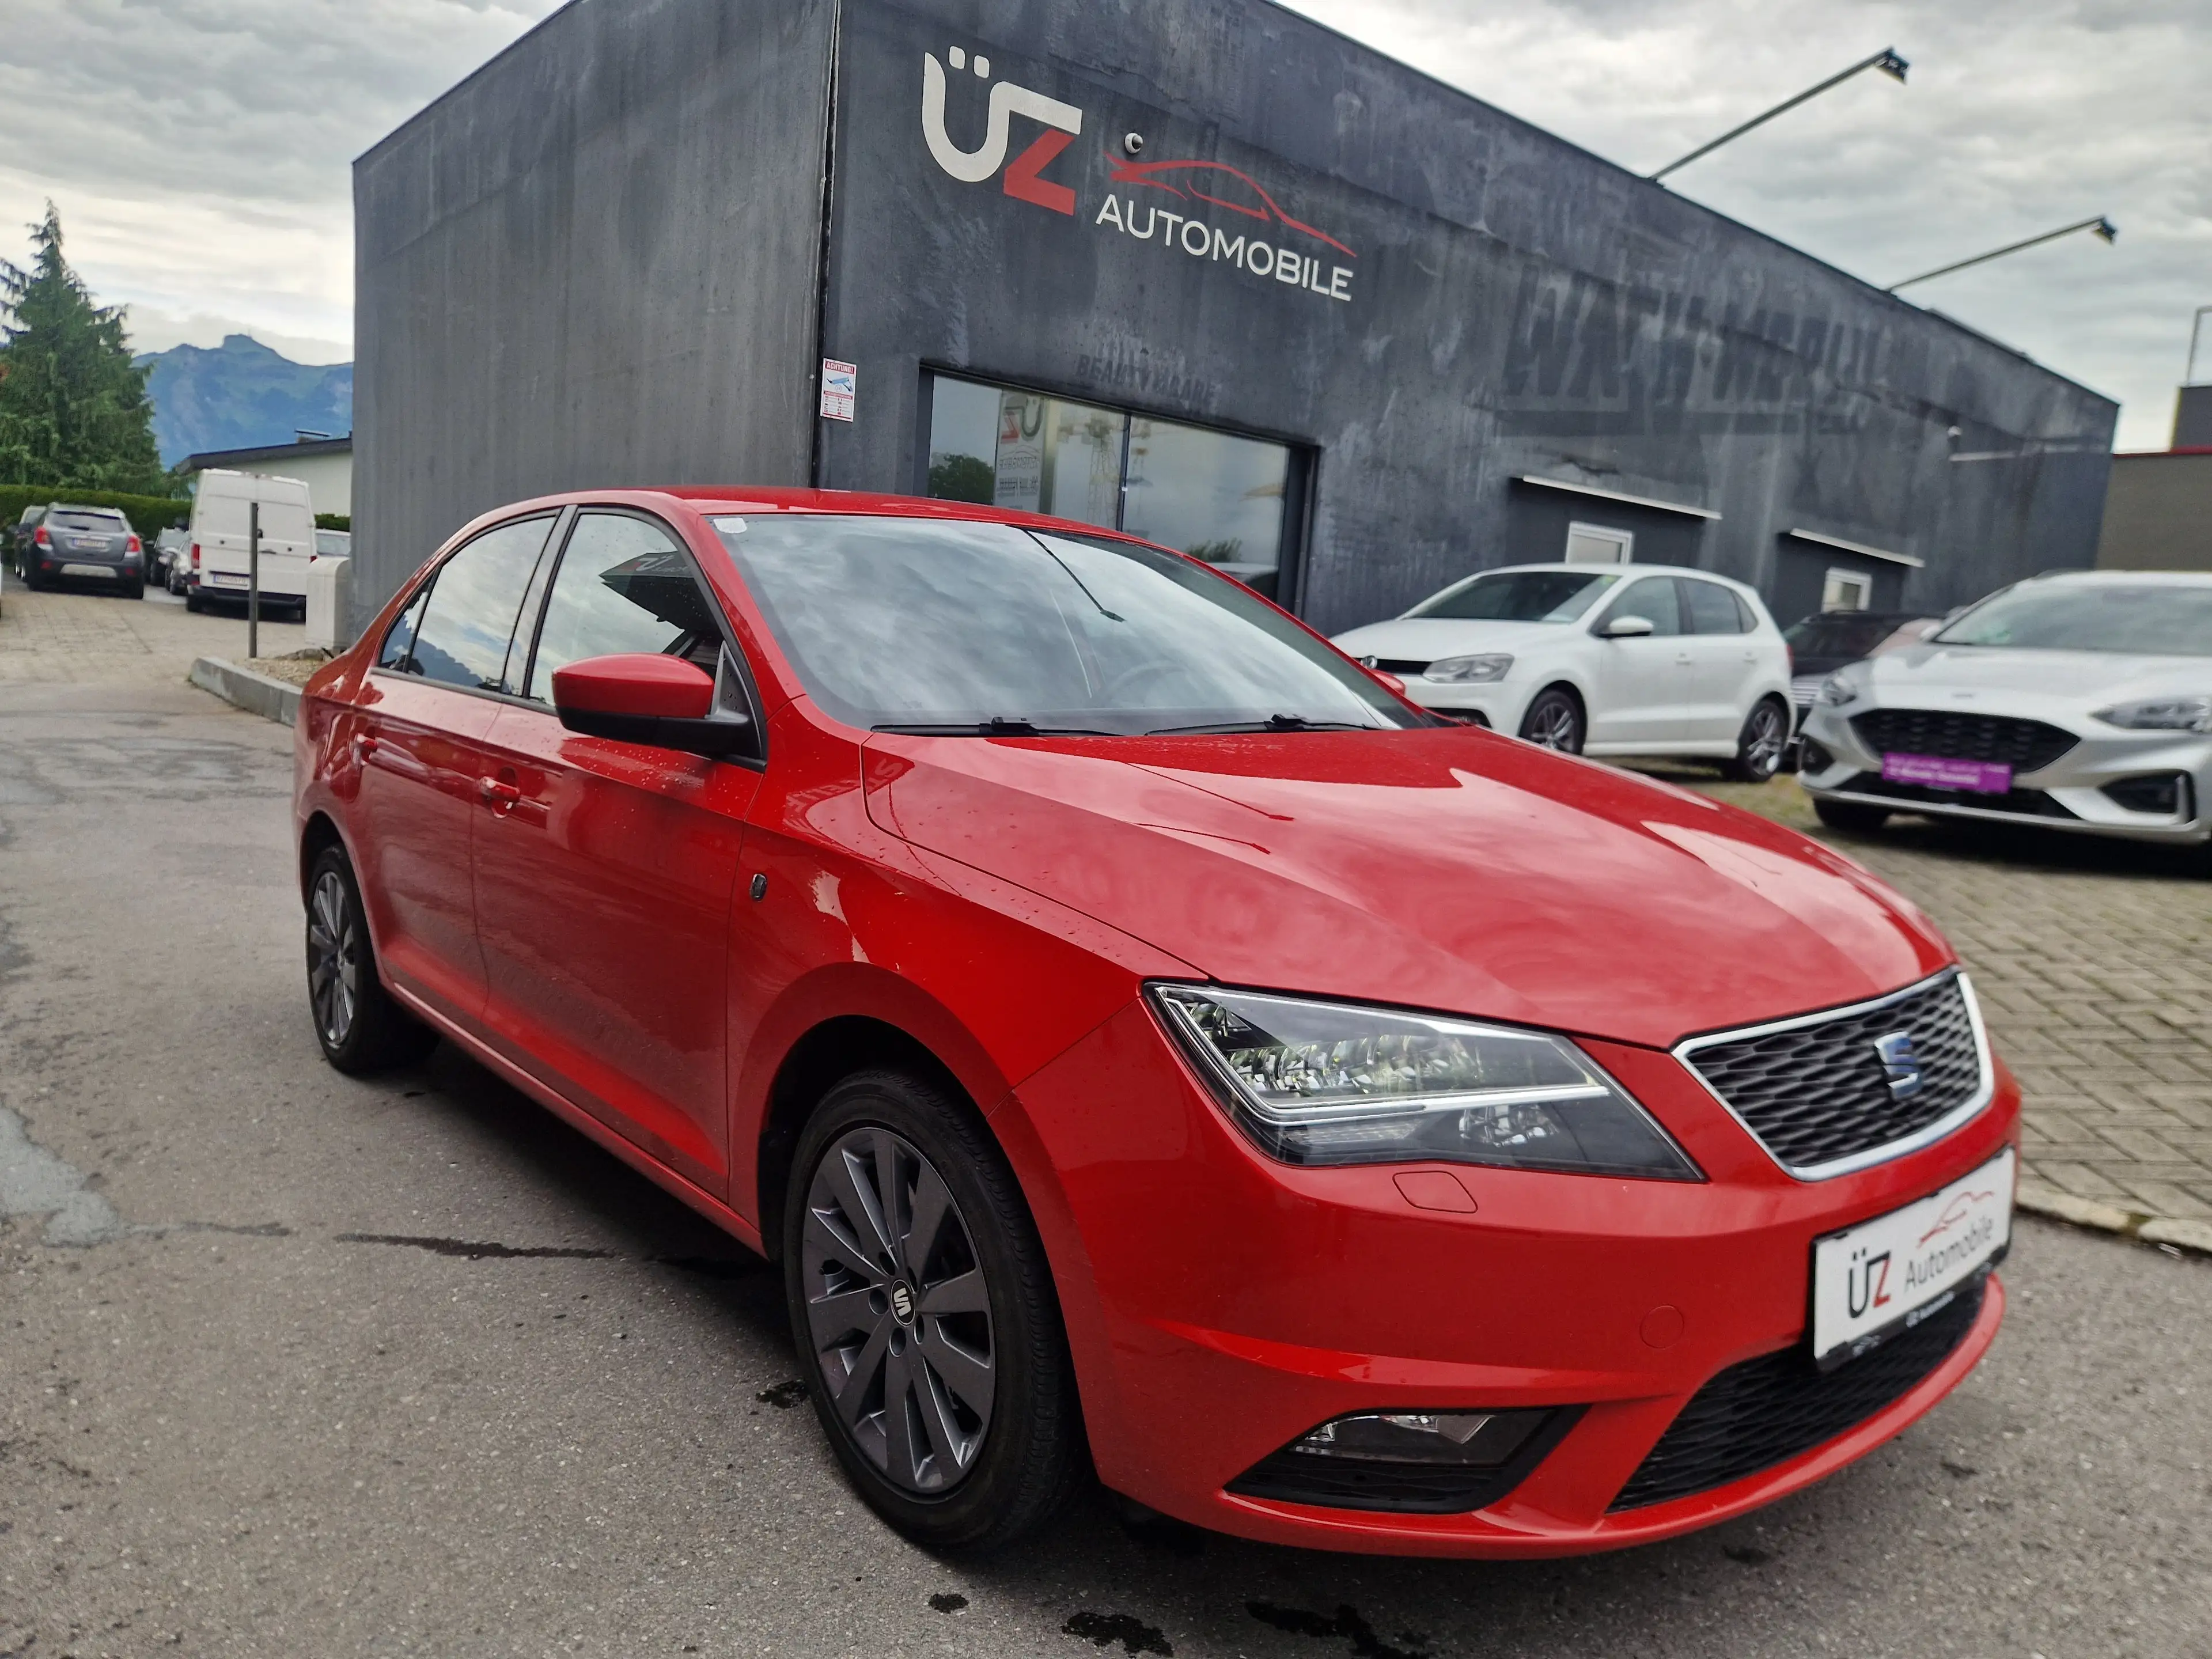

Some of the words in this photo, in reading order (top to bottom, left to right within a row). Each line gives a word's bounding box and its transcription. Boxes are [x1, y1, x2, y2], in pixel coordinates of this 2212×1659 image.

[922, 46, 1083, 216] ÜZ
[1095, 194, 1354, 301] AUTOMOBILE
[826, 361, 854, 374] ACHTUNG!
[1848, 1247, 1891, 1319] ÜZ
[1904, 1215, 1994, 1294] Automobile
